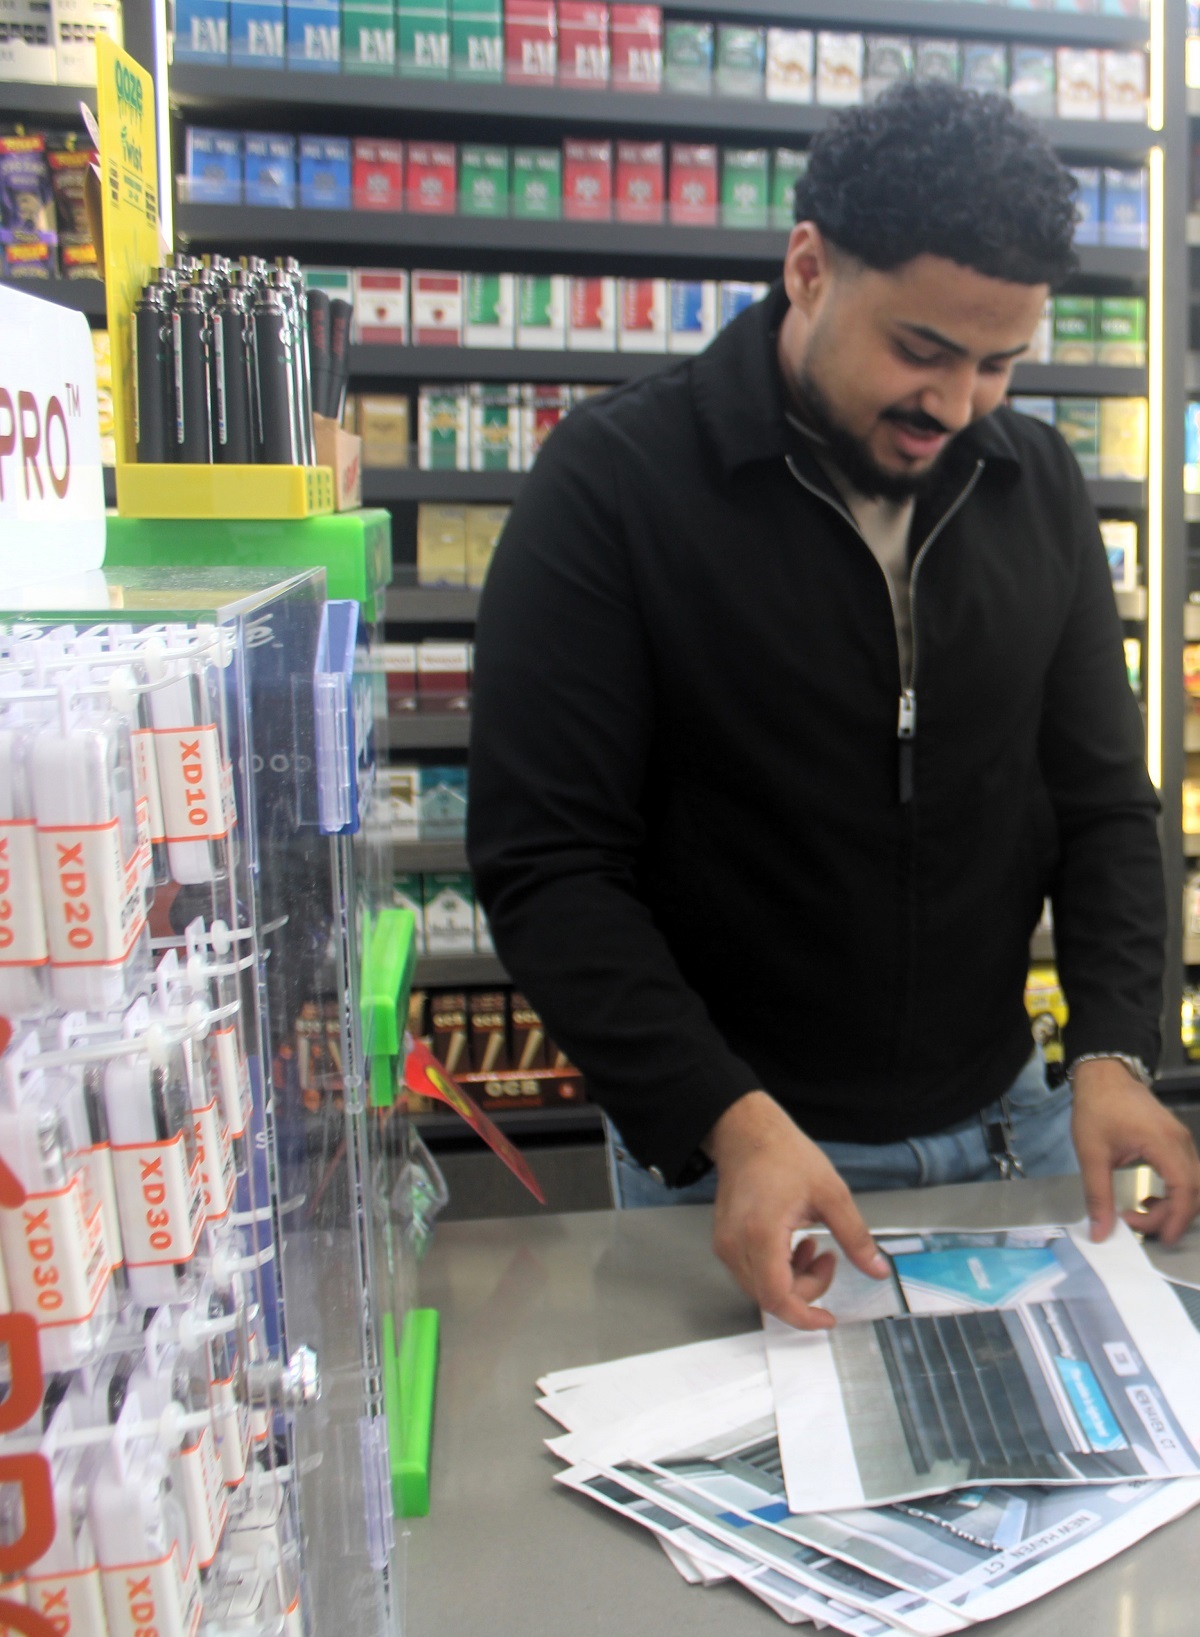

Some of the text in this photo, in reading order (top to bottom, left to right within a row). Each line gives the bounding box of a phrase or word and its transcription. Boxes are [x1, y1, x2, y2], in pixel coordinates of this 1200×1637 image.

[179, 739, 208, 826] XD10
[55, 841, 94, 950] XD20
[139, 1155, 172, 1251] XD30
[22, 1208, 64, 1311] XD30
[981, 1557, 1005, 1577] CT
[1056, 1512, 1090, 1536] NEW
